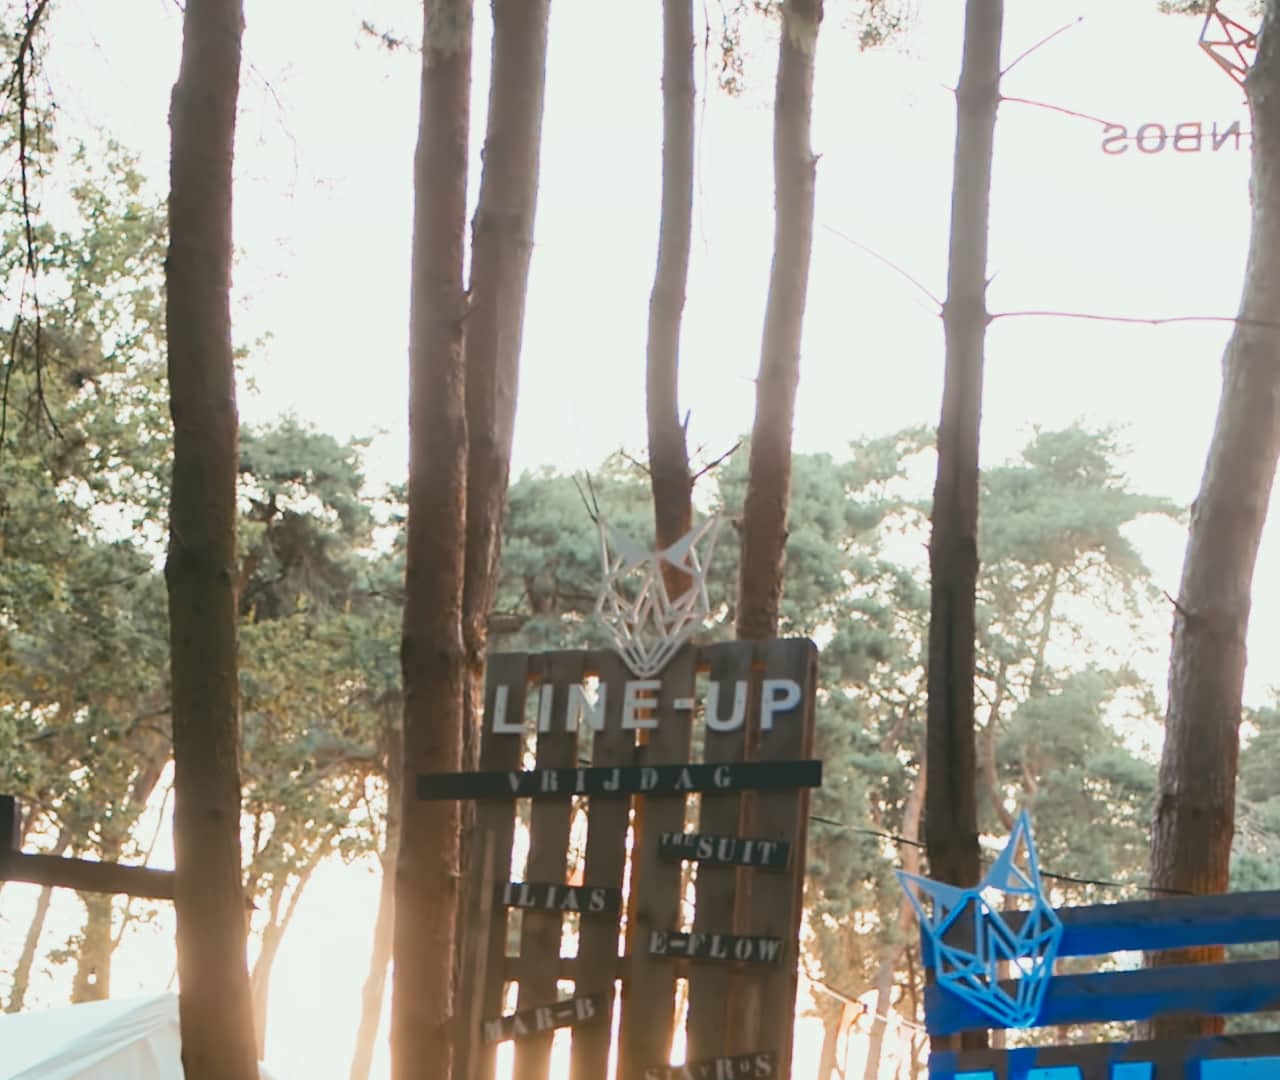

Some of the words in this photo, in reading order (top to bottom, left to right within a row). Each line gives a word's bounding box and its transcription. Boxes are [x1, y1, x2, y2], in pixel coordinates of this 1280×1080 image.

[492, 679, 802, 733] LINE-UP
[508, 766, 733, 793] VRIJDAG
[696, 836, 777, 864] SUIT
[502, 883, 606, 912] ILIAS
[649, 930, 782, 962] E-FLOW
[484, 998, 595, 1042] MAR-B
